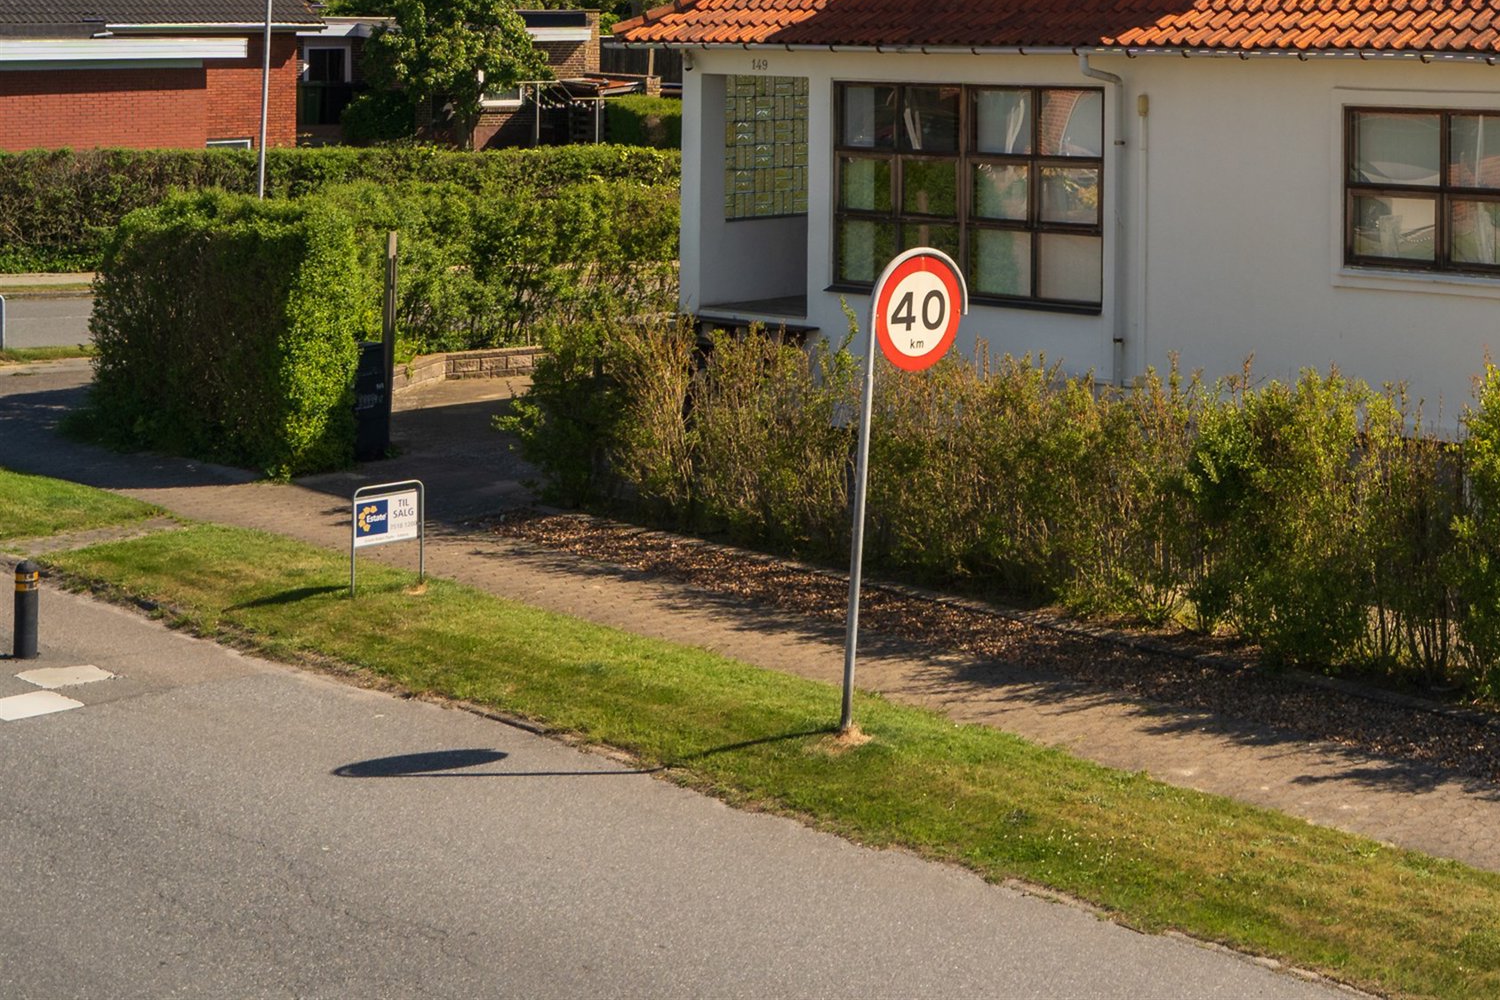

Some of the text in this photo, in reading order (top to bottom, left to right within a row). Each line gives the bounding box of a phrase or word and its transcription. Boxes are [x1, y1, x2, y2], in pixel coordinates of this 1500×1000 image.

[752, 58, 768, 71] 149
[891, 290, 946, 331] 40
[910, 338, 925, 349] km
[398, 499, 410, 507] TIL
[366, 513, 387, 523] Estate
[393, 508, 414, 519] SALG
